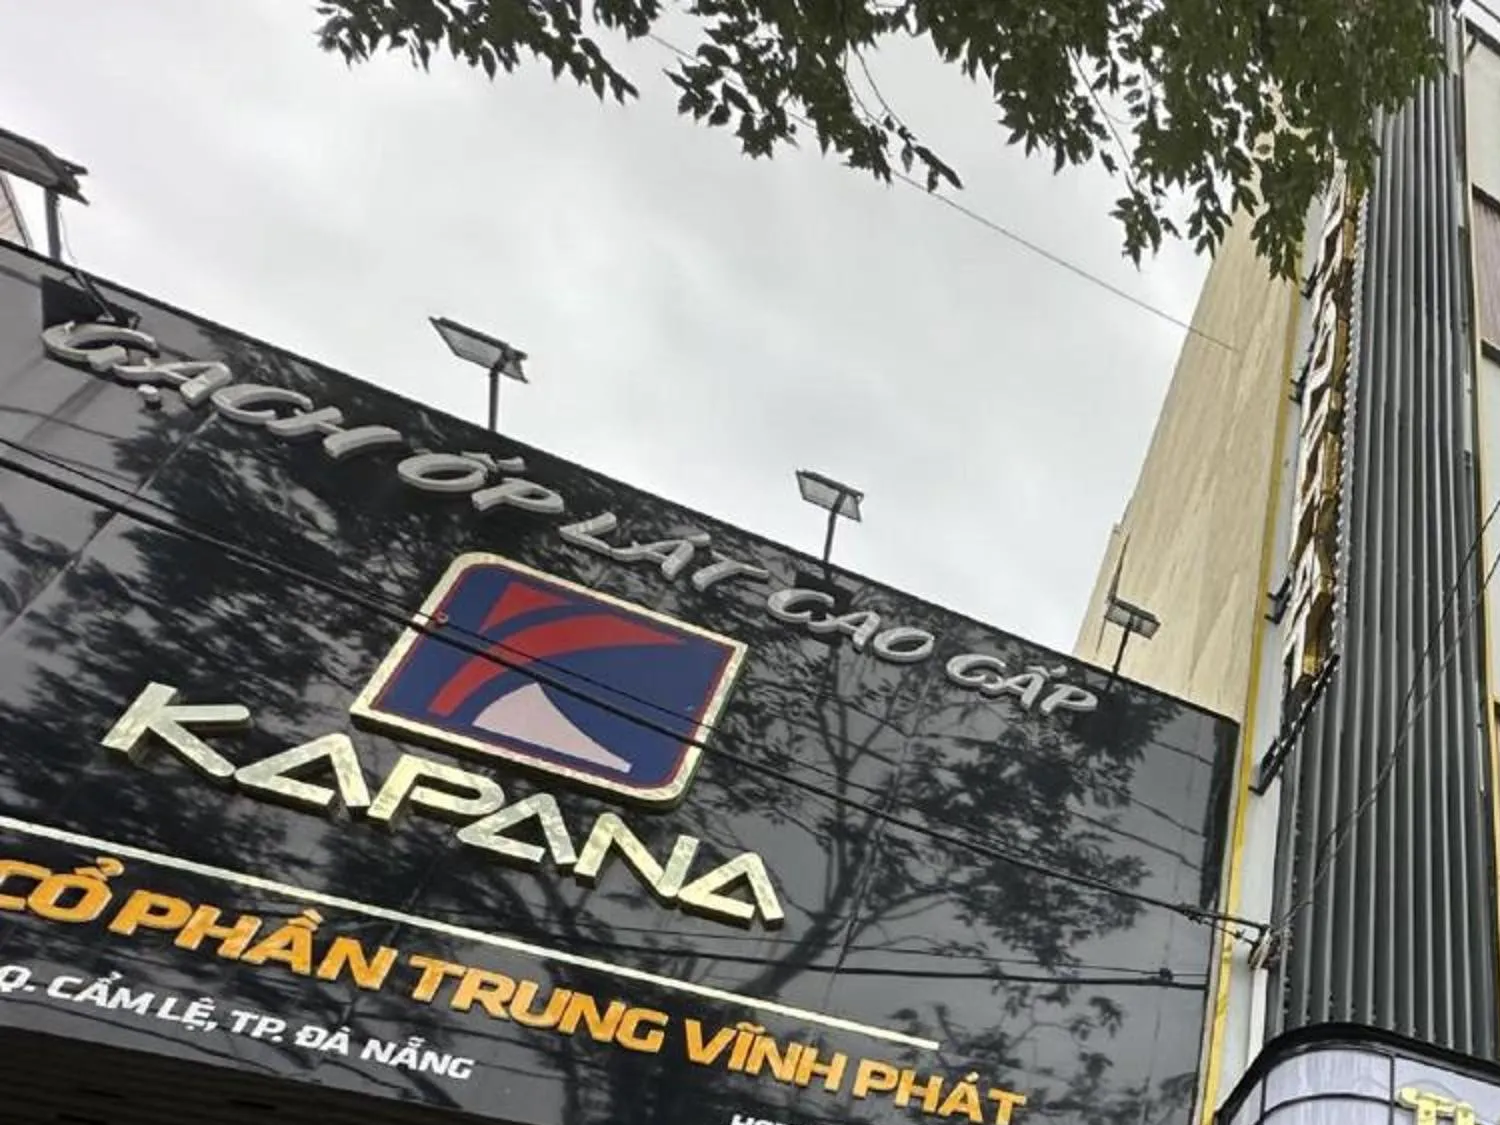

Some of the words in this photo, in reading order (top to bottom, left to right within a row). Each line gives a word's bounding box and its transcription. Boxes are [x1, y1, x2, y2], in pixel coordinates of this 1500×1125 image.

[767, 587, 935, 666] CAO
[945, 654, 1099, 717] CẤP
[101, 681, 785, 927] KAPANA
[0, 856, 125, 924] CỔ
[106, 889, 399, 991] PHẦN
[409, 953, 669, 1054] TRUNG
[684, 1020, 847, 1092] VĨNH
[47, 970, 155, 1015] CẨM
[231, 1009, 288, 1043] TP.
[294, 1025, 350, 1056] ĐÀ
[361, 1034, 475, 1083] NẴNG
